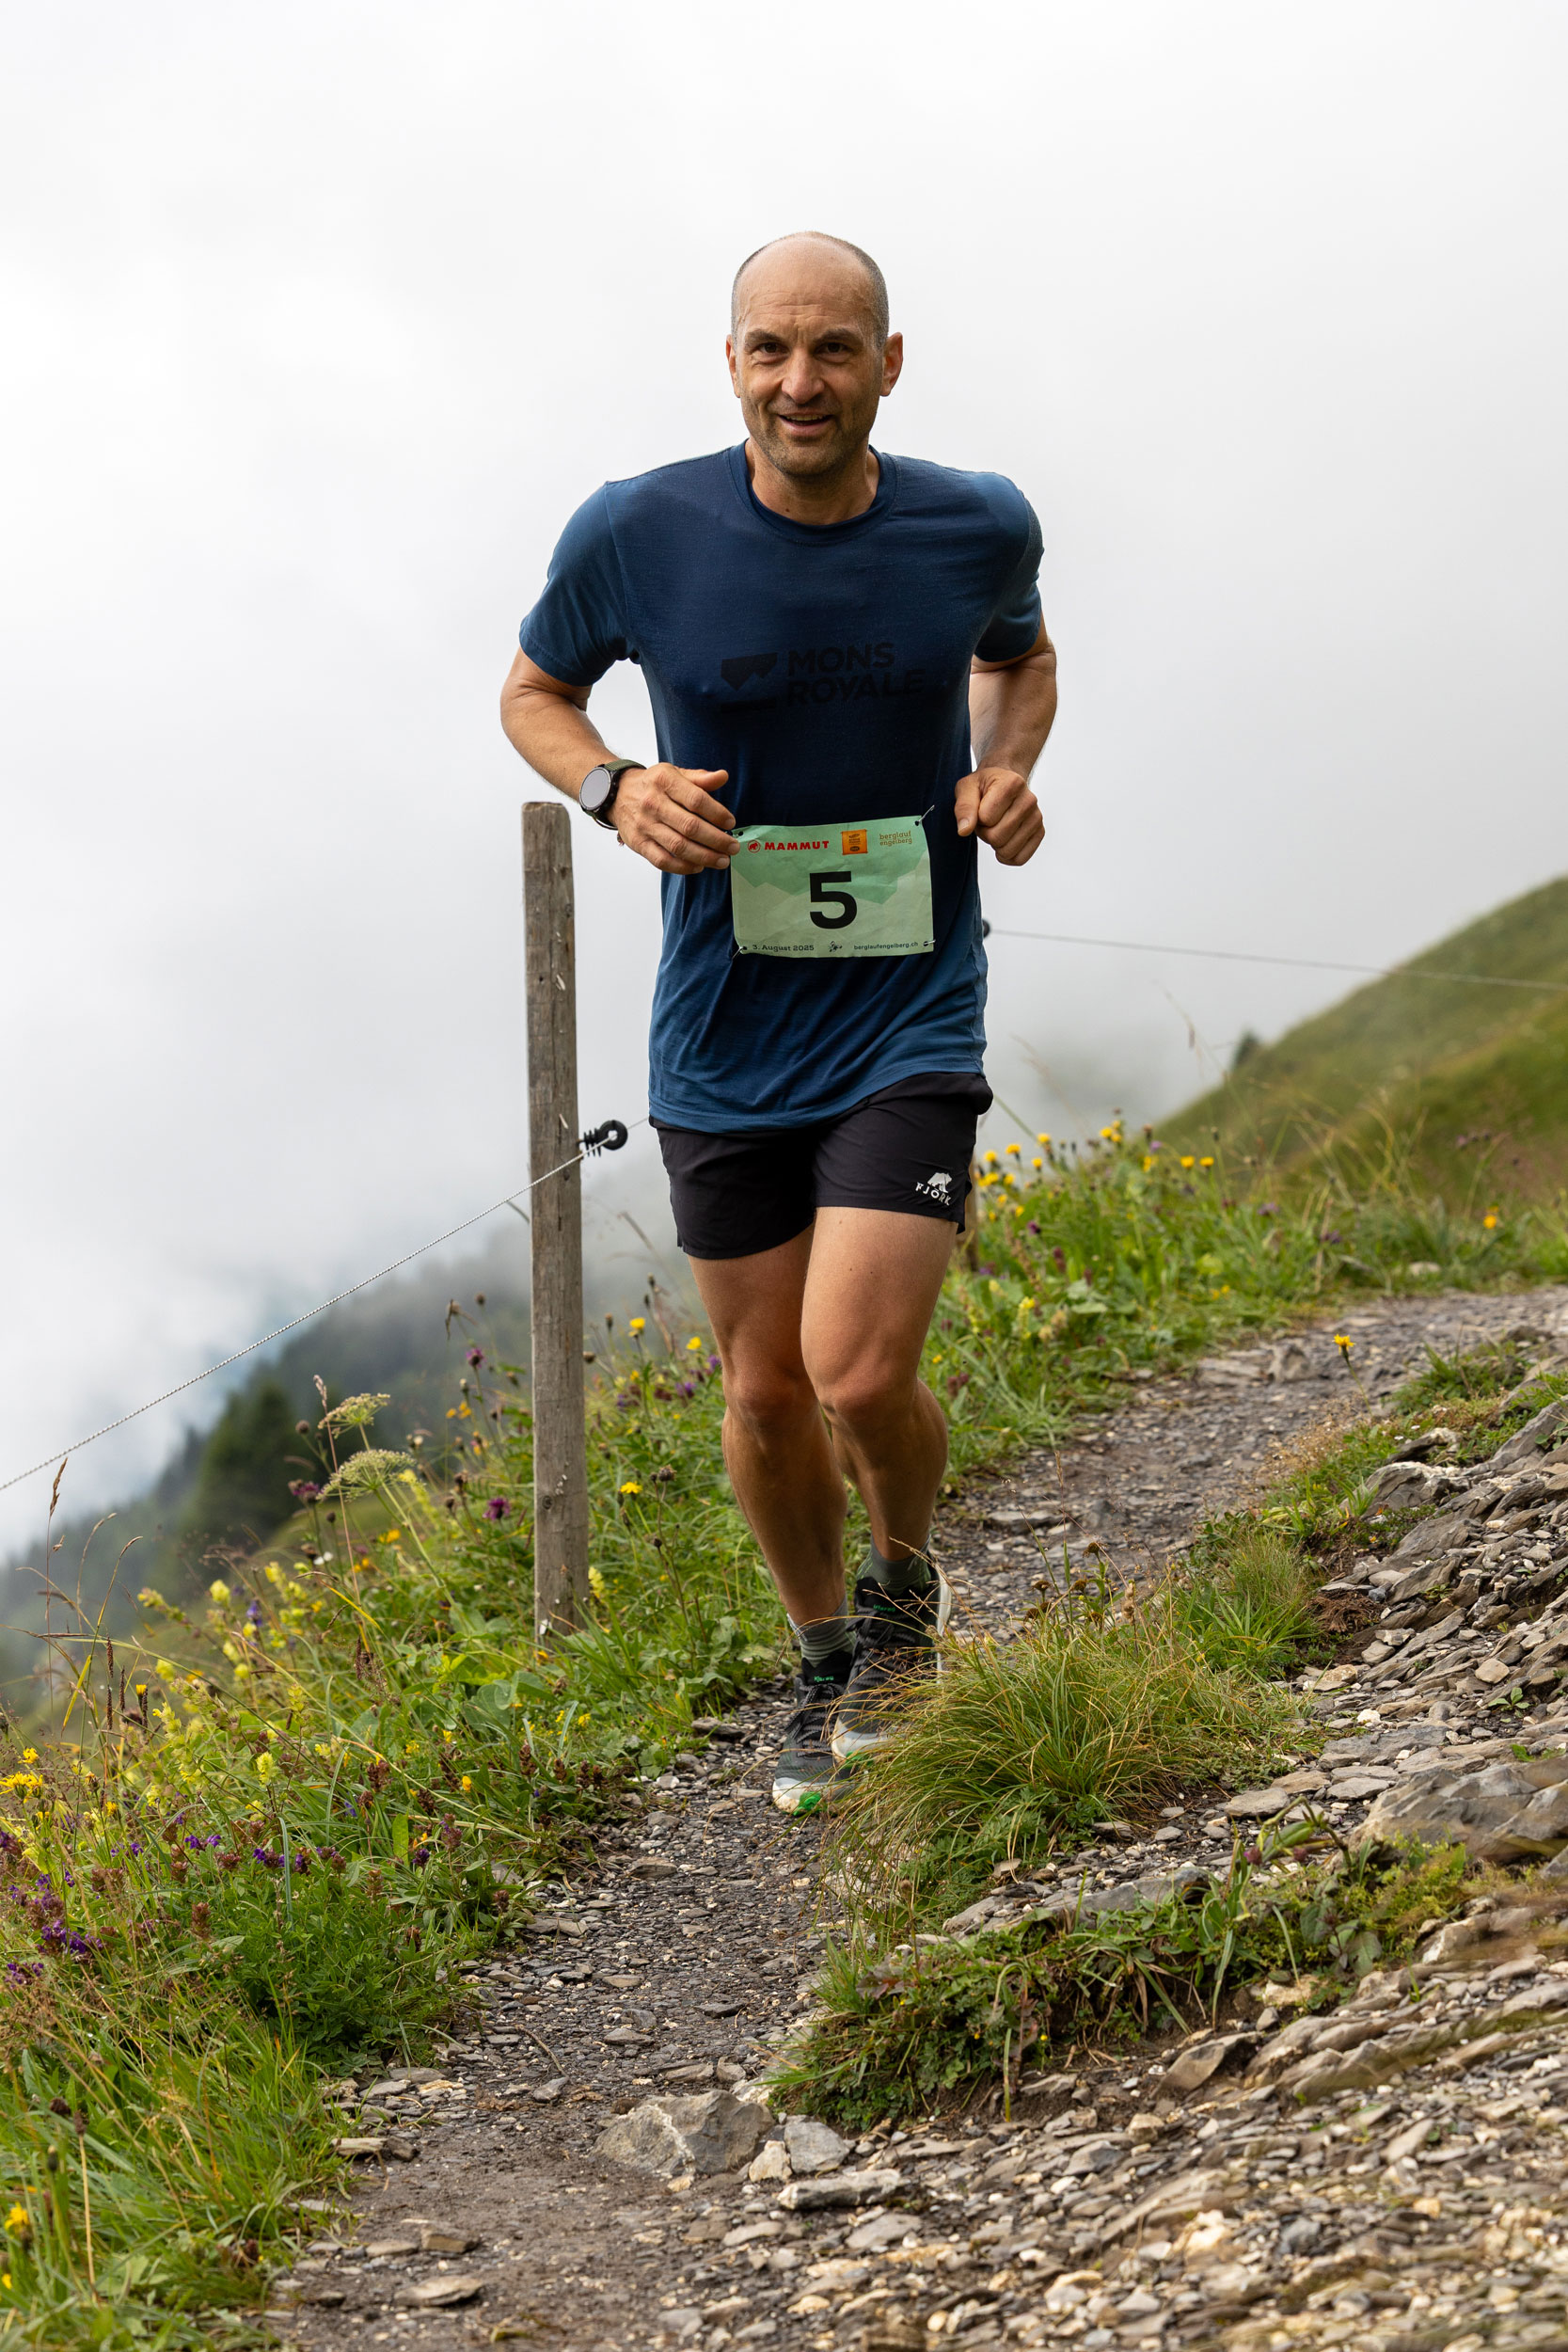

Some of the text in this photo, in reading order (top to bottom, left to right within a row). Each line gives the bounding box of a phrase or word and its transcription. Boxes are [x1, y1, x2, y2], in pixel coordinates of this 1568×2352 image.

[787, 643, 895, 676] MONS
[786, 669, 927, 707] ROYALE
[879, 830, 911, 841] berglauf
[764, 840, 830, 851] MAMMUT
[879, 836, 912, 847] engelberg
[809, 870, 858, 930] 5
[762, 944, 791, 952] August
[853, 941, 918, 951] berglaufengelberg.ch
